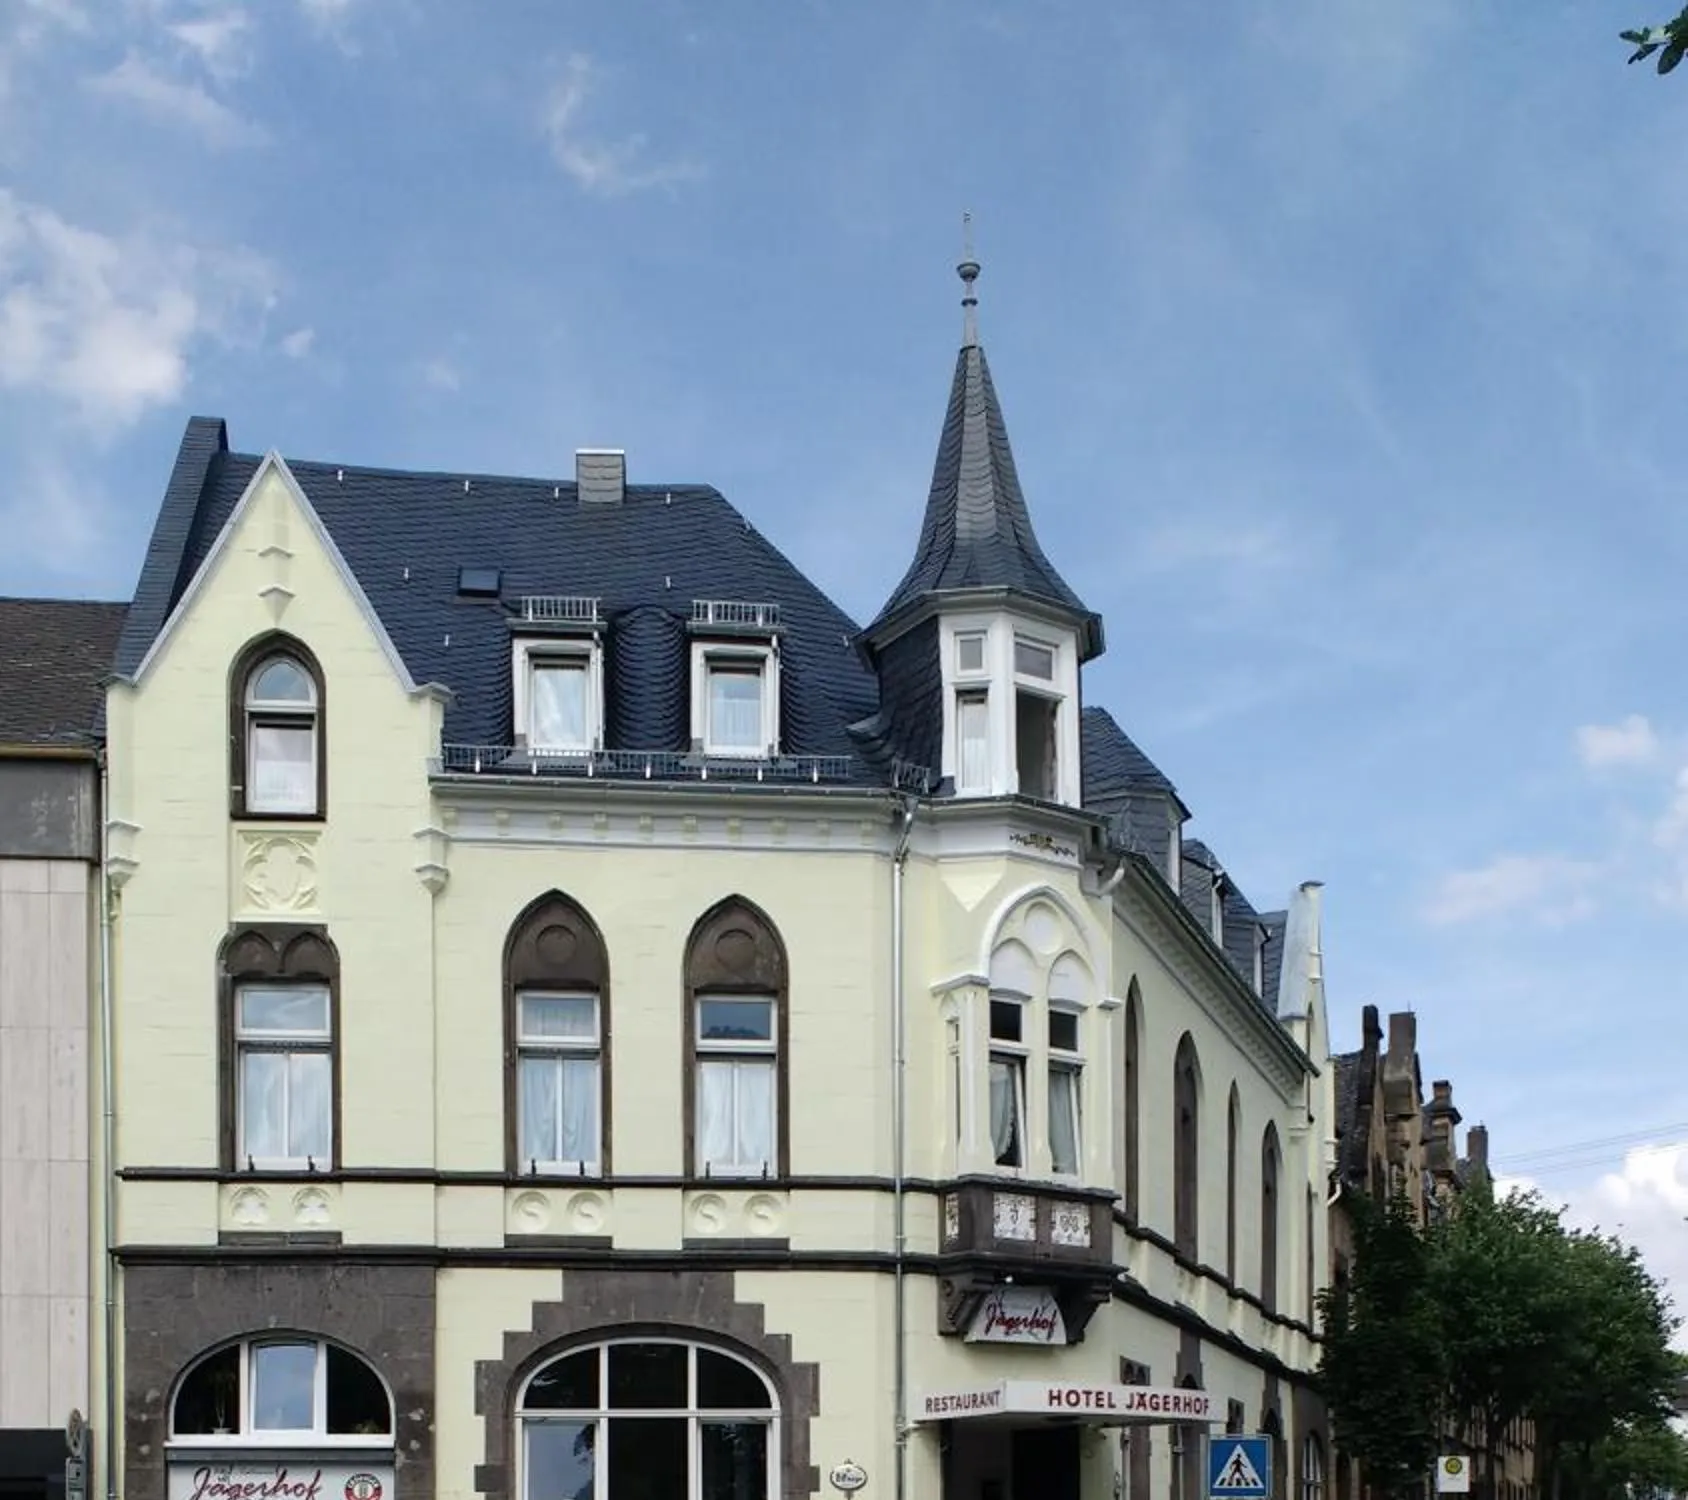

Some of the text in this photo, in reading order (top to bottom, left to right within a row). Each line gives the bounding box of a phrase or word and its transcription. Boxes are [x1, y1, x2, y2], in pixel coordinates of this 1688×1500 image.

[925, 1389, 1001, 1413] RESTAURANT
[1048, 1389, 1209, 1416] HOTEL JÄGERHOF
